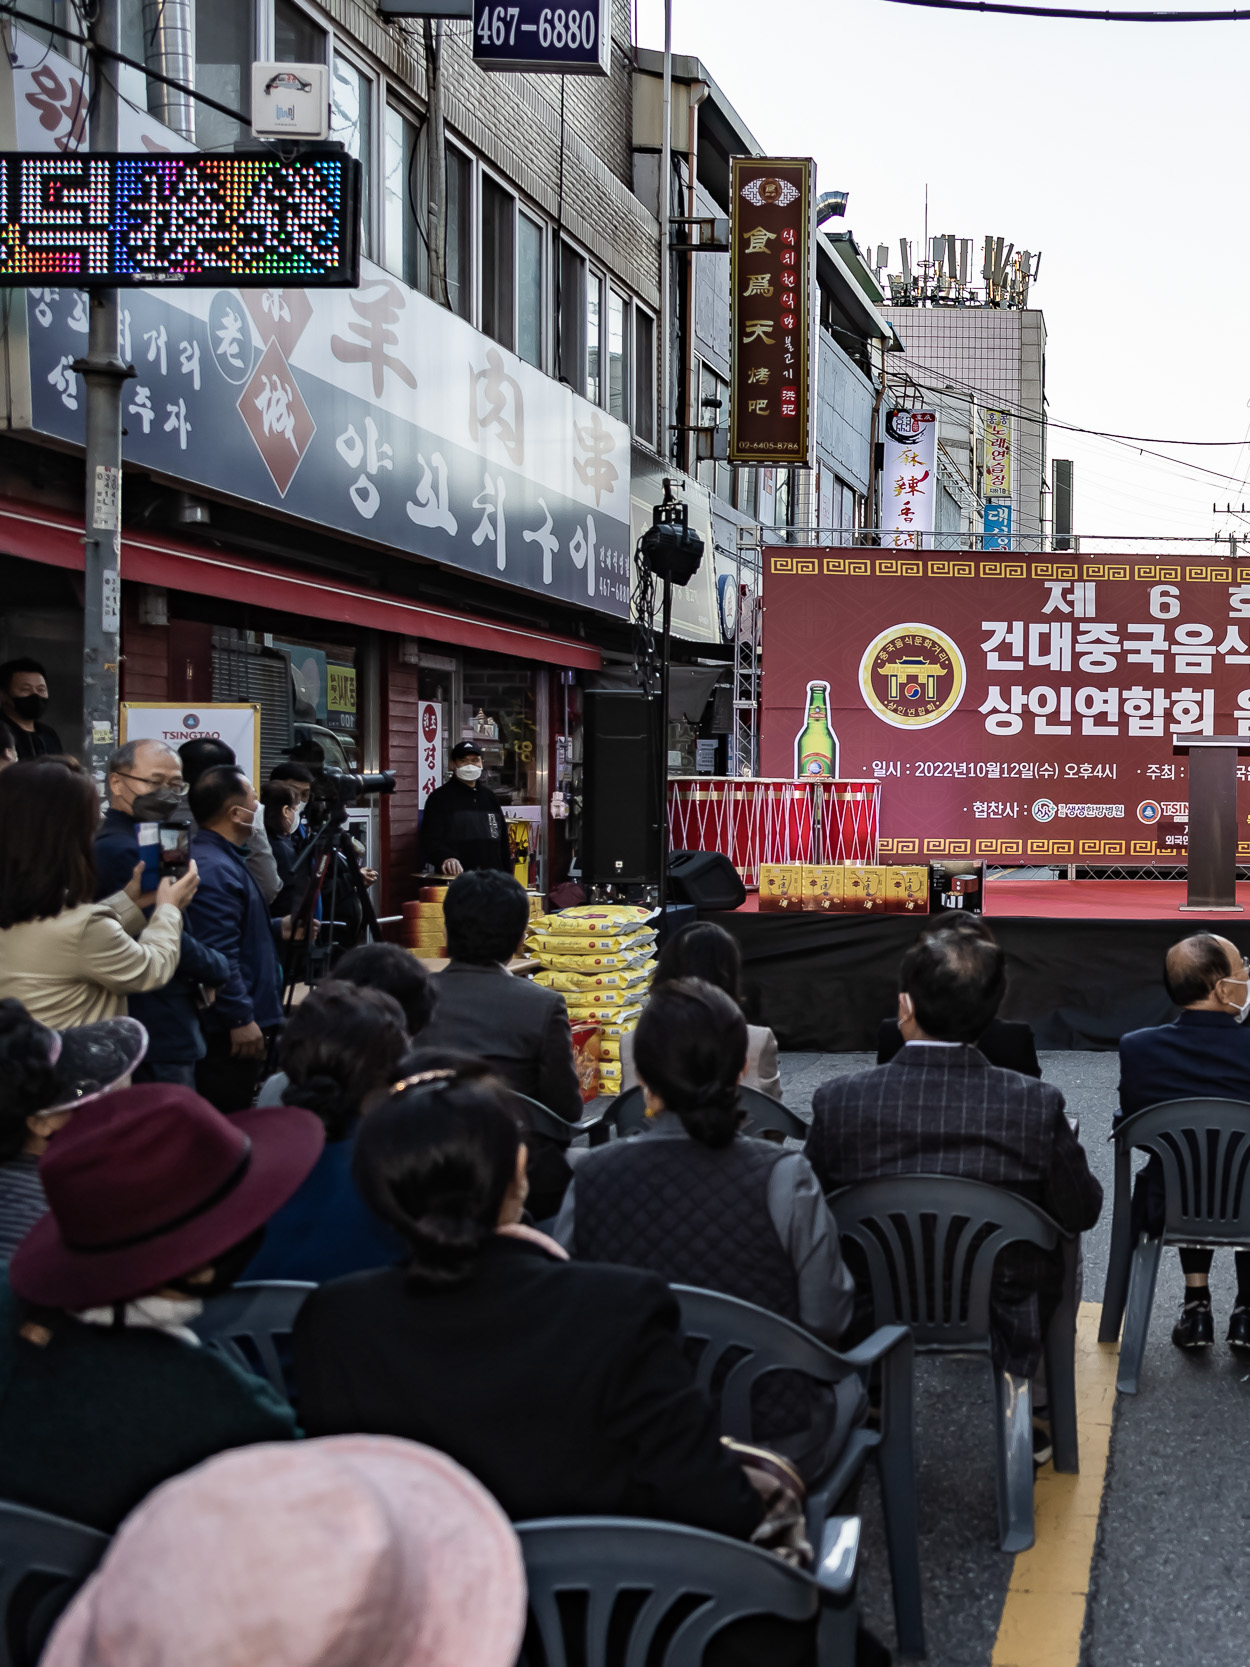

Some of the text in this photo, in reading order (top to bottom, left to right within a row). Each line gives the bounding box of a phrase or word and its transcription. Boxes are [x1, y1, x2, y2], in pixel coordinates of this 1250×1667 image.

[477, 6, 595, 49] 467-6880
[780, 228, 797, 330] 식위천식당
[784, 336, 794, 379] 불고기
[748, 368, 770, 416] 烤吧
[739, 441, 798, 450] 02-6405-8786
[1041, 582, 1096, 618] 제
[1149, 584, 1181, 620] 6
[878, 635, 949, 662] 중국음식문화거리
[887, 702, 936, 717] 상인연합회
[978, 685, 1215, 736] 상인연합회
[162, 731, 220, 741] TSINGTAO
[872, 761, 901, 777] 일시
[915, 761, 1059, 780] 2022년10월12일(수)
[1064, 763, 1117, 780] 오후4시
[1146, 764, 1175, 781] 주최
[972, 802, 1019, 819] 협찬사
[1066, 804, 1125, 818] 생생한방병원
